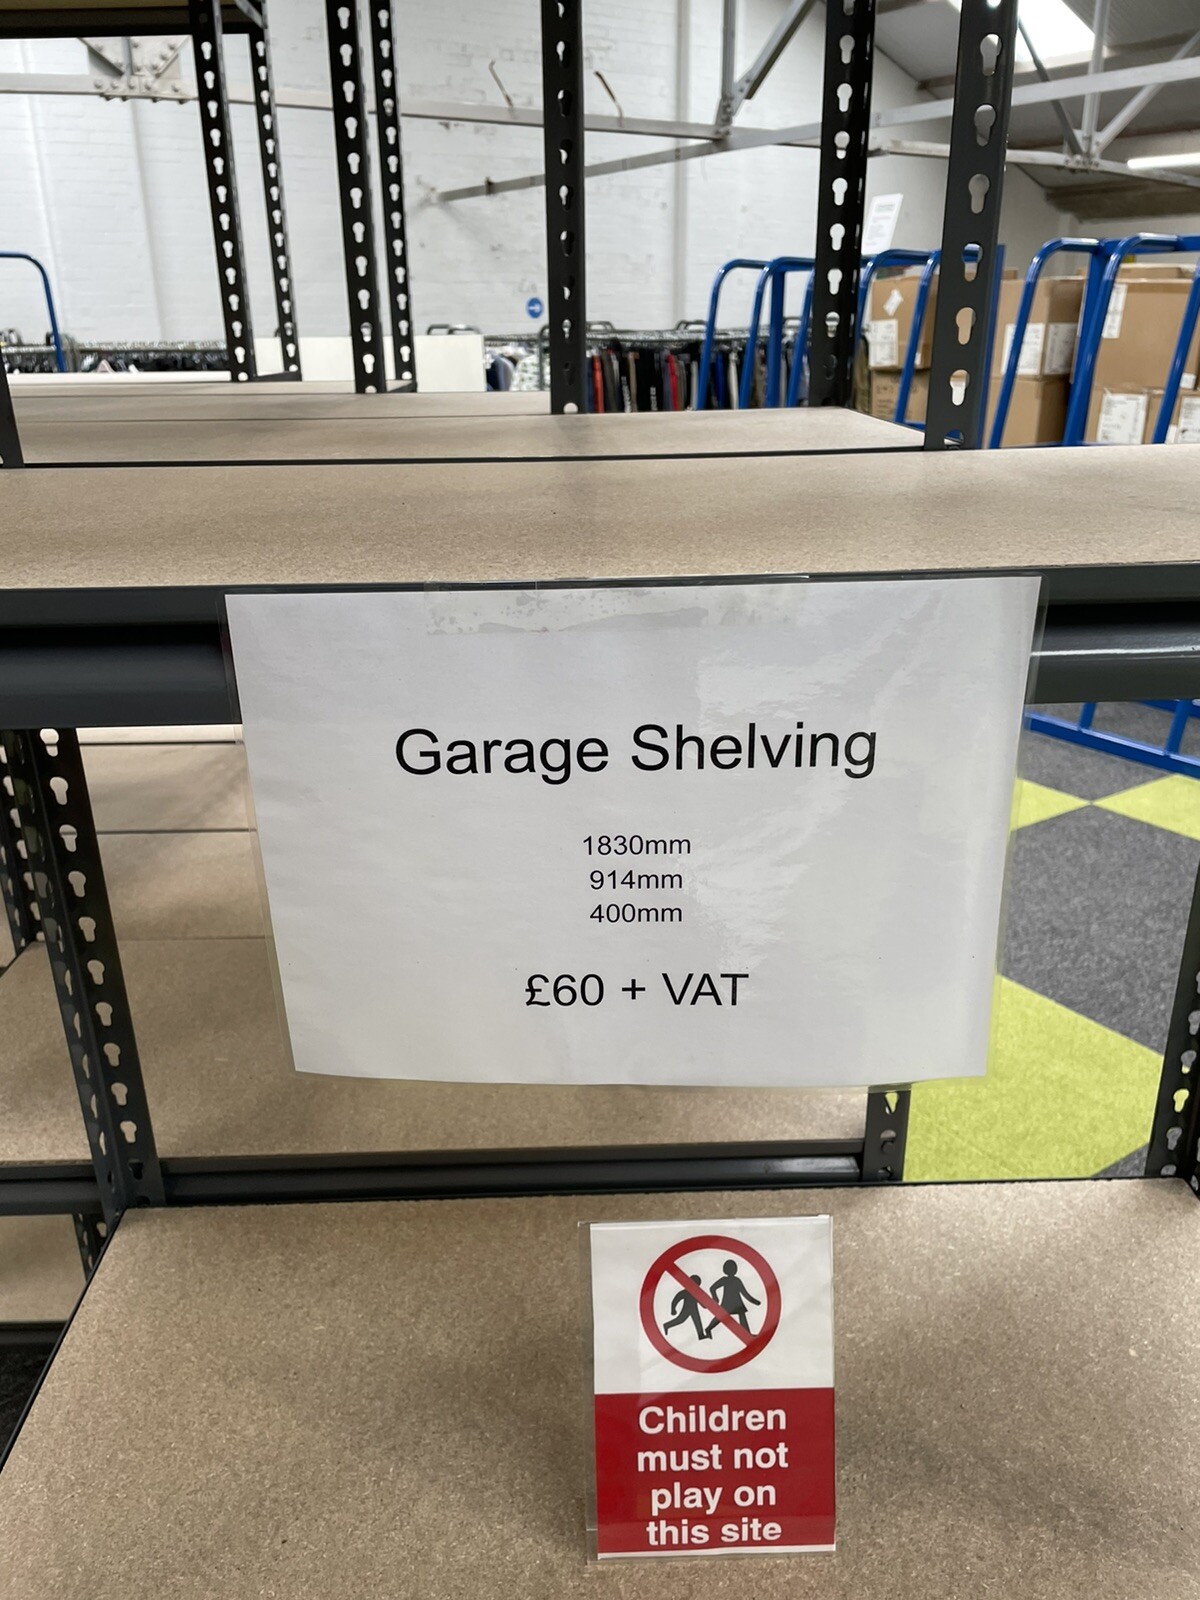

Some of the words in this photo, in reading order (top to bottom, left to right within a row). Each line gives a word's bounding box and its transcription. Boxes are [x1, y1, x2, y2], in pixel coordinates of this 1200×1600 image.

[395, 728, 609, 785] Garage
[631, 721, 877, 778] Shelving
[582, 834, 692, 856] 1830mm
[589, 869, 683, 890] 914mm
[589, 903, 683, 923] 400mm
[525, 973, 605, 1007] £60
[621, 978, 646, 1001] +
[661, 972, 750, 1006] VAT
[638, 1404, 787, 1434] Children
[637, 1444, 722, 1472] must
[733, 1442, 789, 1469] not
[650, 1481, 723, 1516] play
[733, 1484, 776, 1507] on
[645, 1518, 710, 1546] this
[720, 1516, 782, 1542] site
